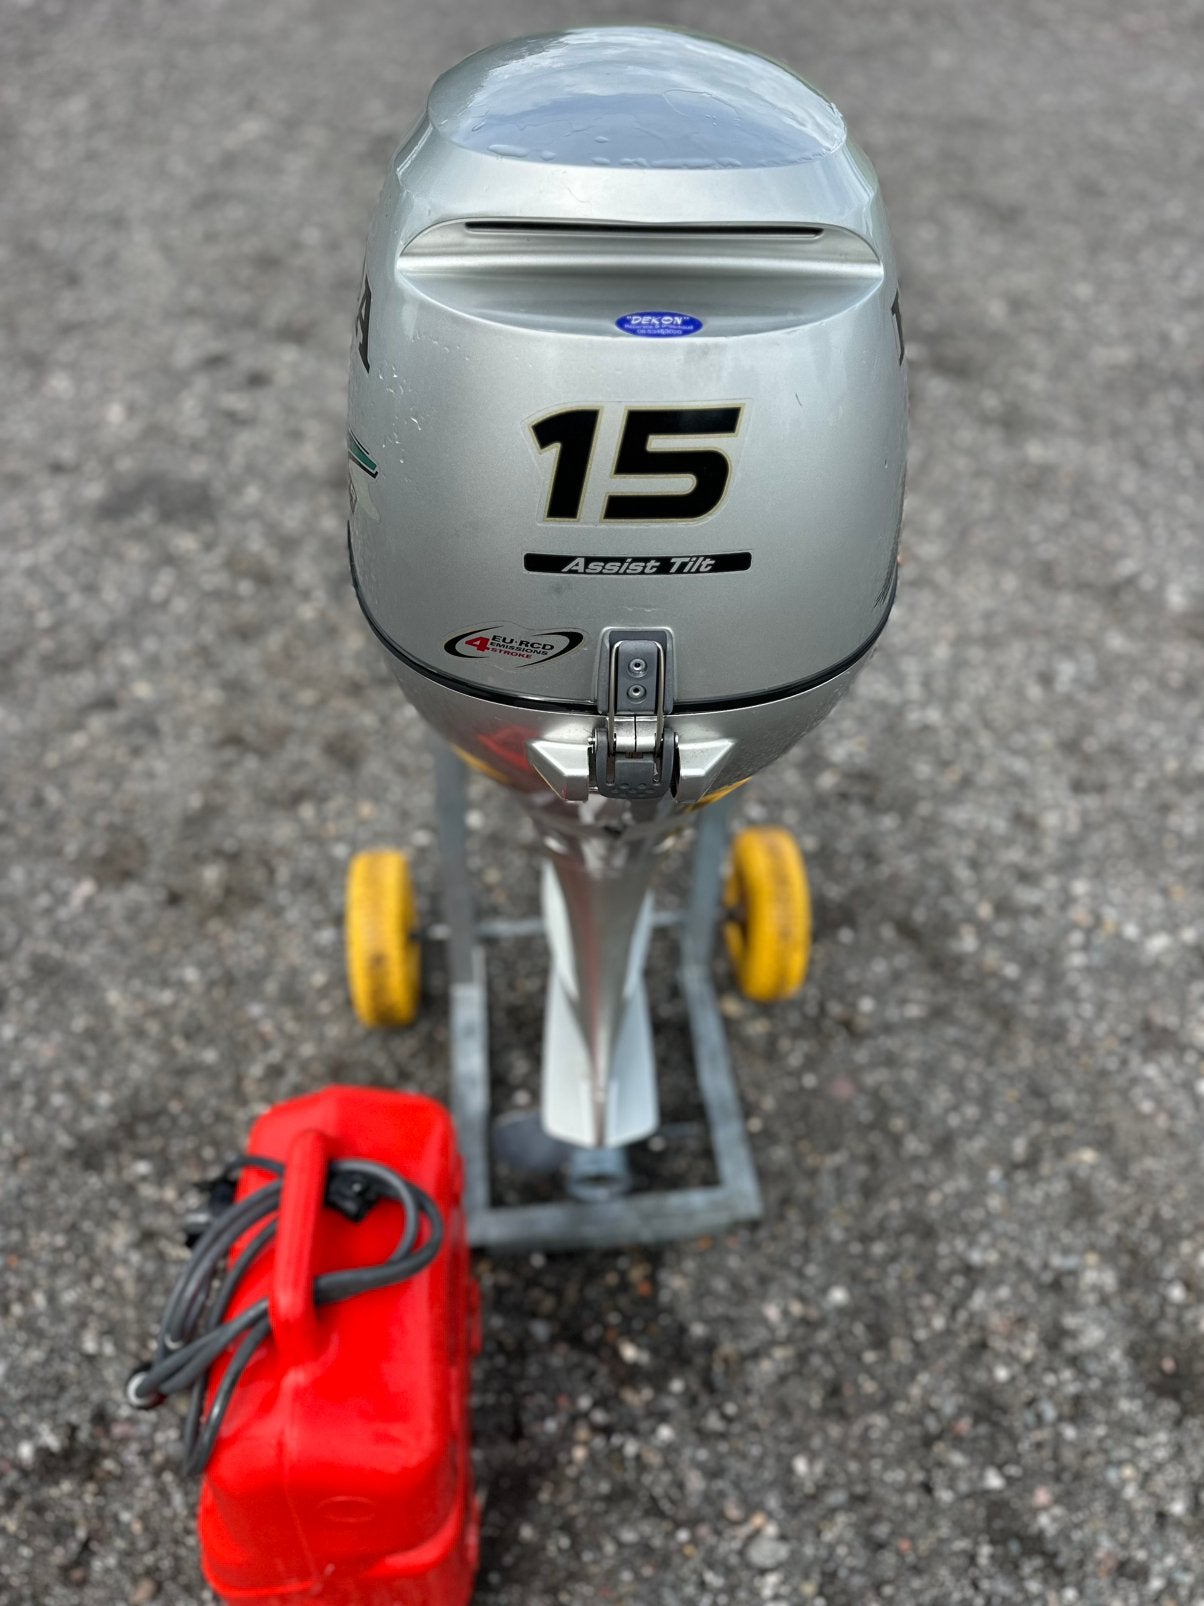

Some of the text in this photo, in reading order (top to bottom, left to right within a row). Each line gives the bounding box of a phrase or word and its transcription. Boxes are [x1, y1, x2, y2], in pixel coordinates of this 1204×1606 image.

[528, 403, 746, 524] 15
[561, 556, 715, 574] Assist Tilt
[465, 636, 532, 659] 4 STROKE
[489, 642, 550, 656] EMISSIONS
